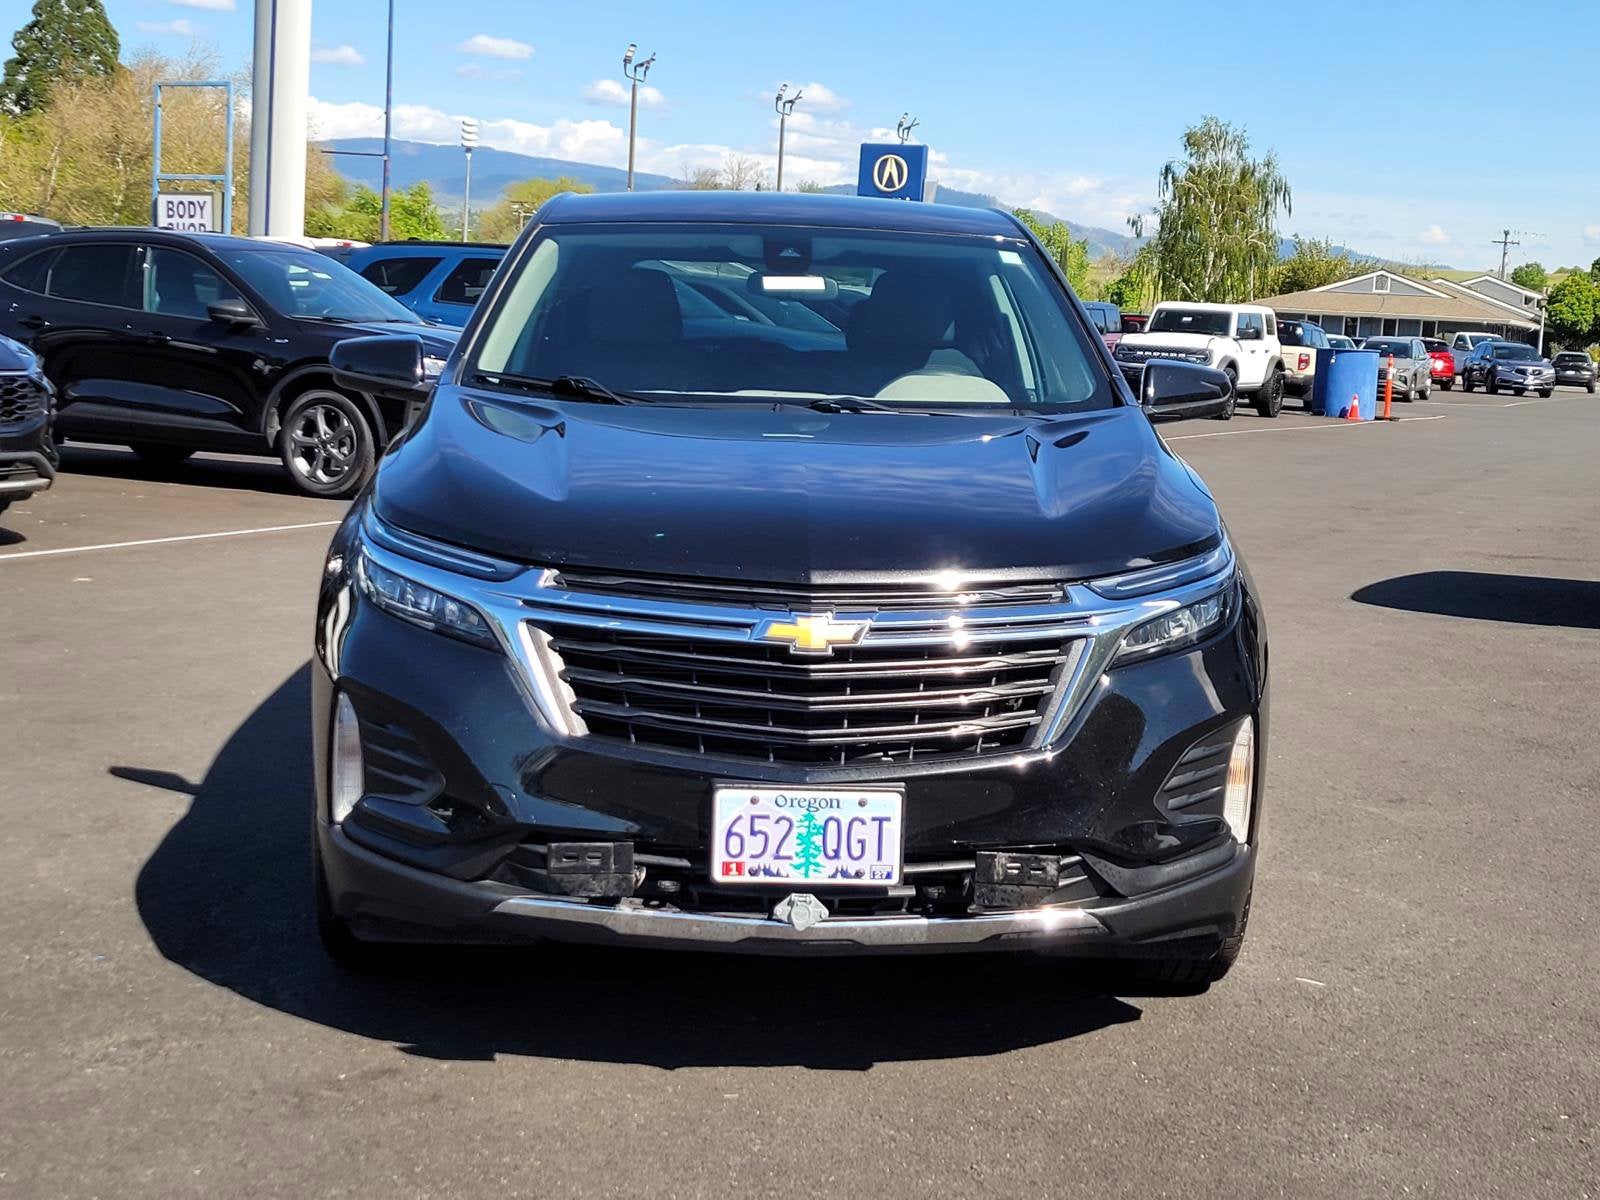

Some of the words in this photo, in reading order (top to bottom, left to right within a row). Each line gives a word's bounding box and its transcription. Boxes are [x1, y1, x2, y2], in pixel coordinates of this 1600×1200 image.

[166, 200, 207, 219] BODY
[774, 794, 842, 812] Oregon
[725, 814, 795, 860] 652
[822, 815, 891, 861] QGT
